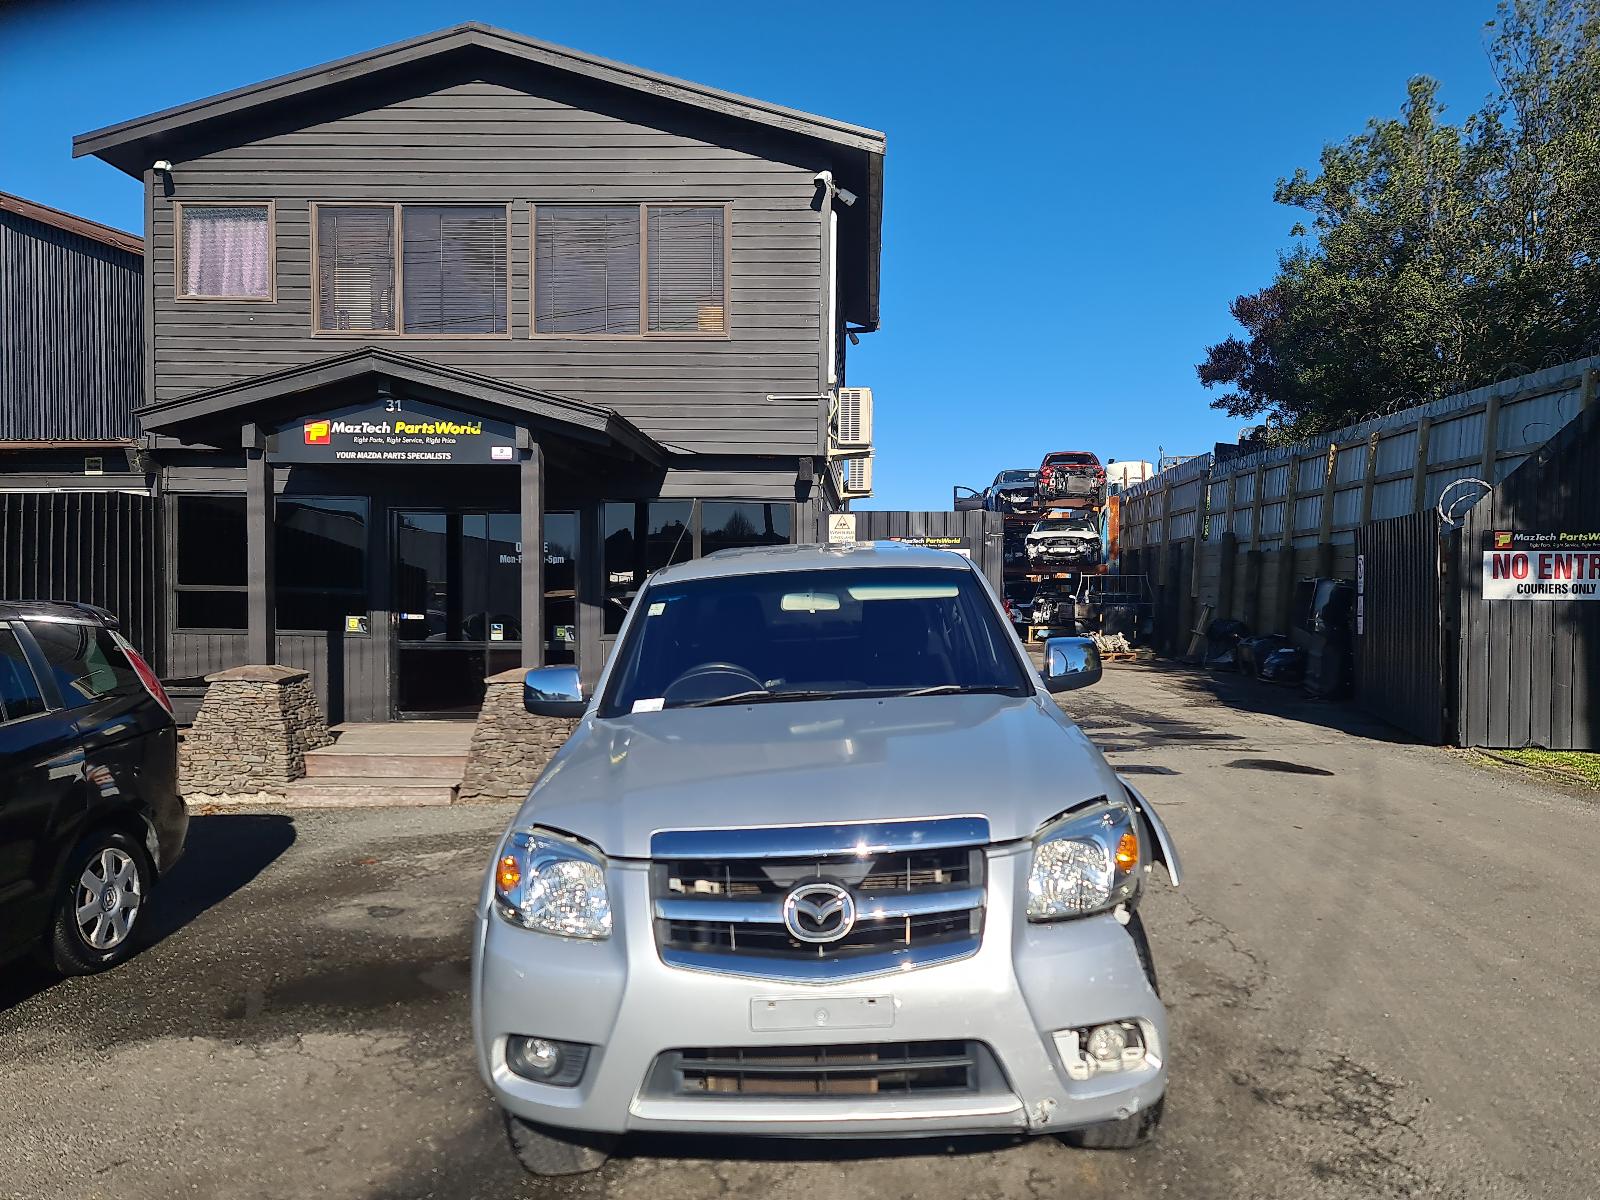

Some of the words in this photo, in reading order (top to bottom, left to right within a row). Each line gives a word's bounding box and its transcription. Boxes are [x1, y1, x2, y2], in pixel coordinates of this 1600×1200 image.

[386, 400, 402, 411] 31
[331, 421, 391, 433] MazTech
[395, 421, 482, 434] PartsWorld
[353, 436, 368, 444] Right
[387, 436, 401, 444] Right
[425, 437, 441, 445] Right
[407, 452, 452, 460] SPECIALISTS
[1560, 532, 1600, 541] PartsW
[500, 555, 522, 563] Mon-F
[1493, 553, 1528, 579] NO
[1538, 553, 1600, 579] ENTR
[1516, 584, 1568, 594] COURIERS
[1571, 584, 1597, 594] ONLY
